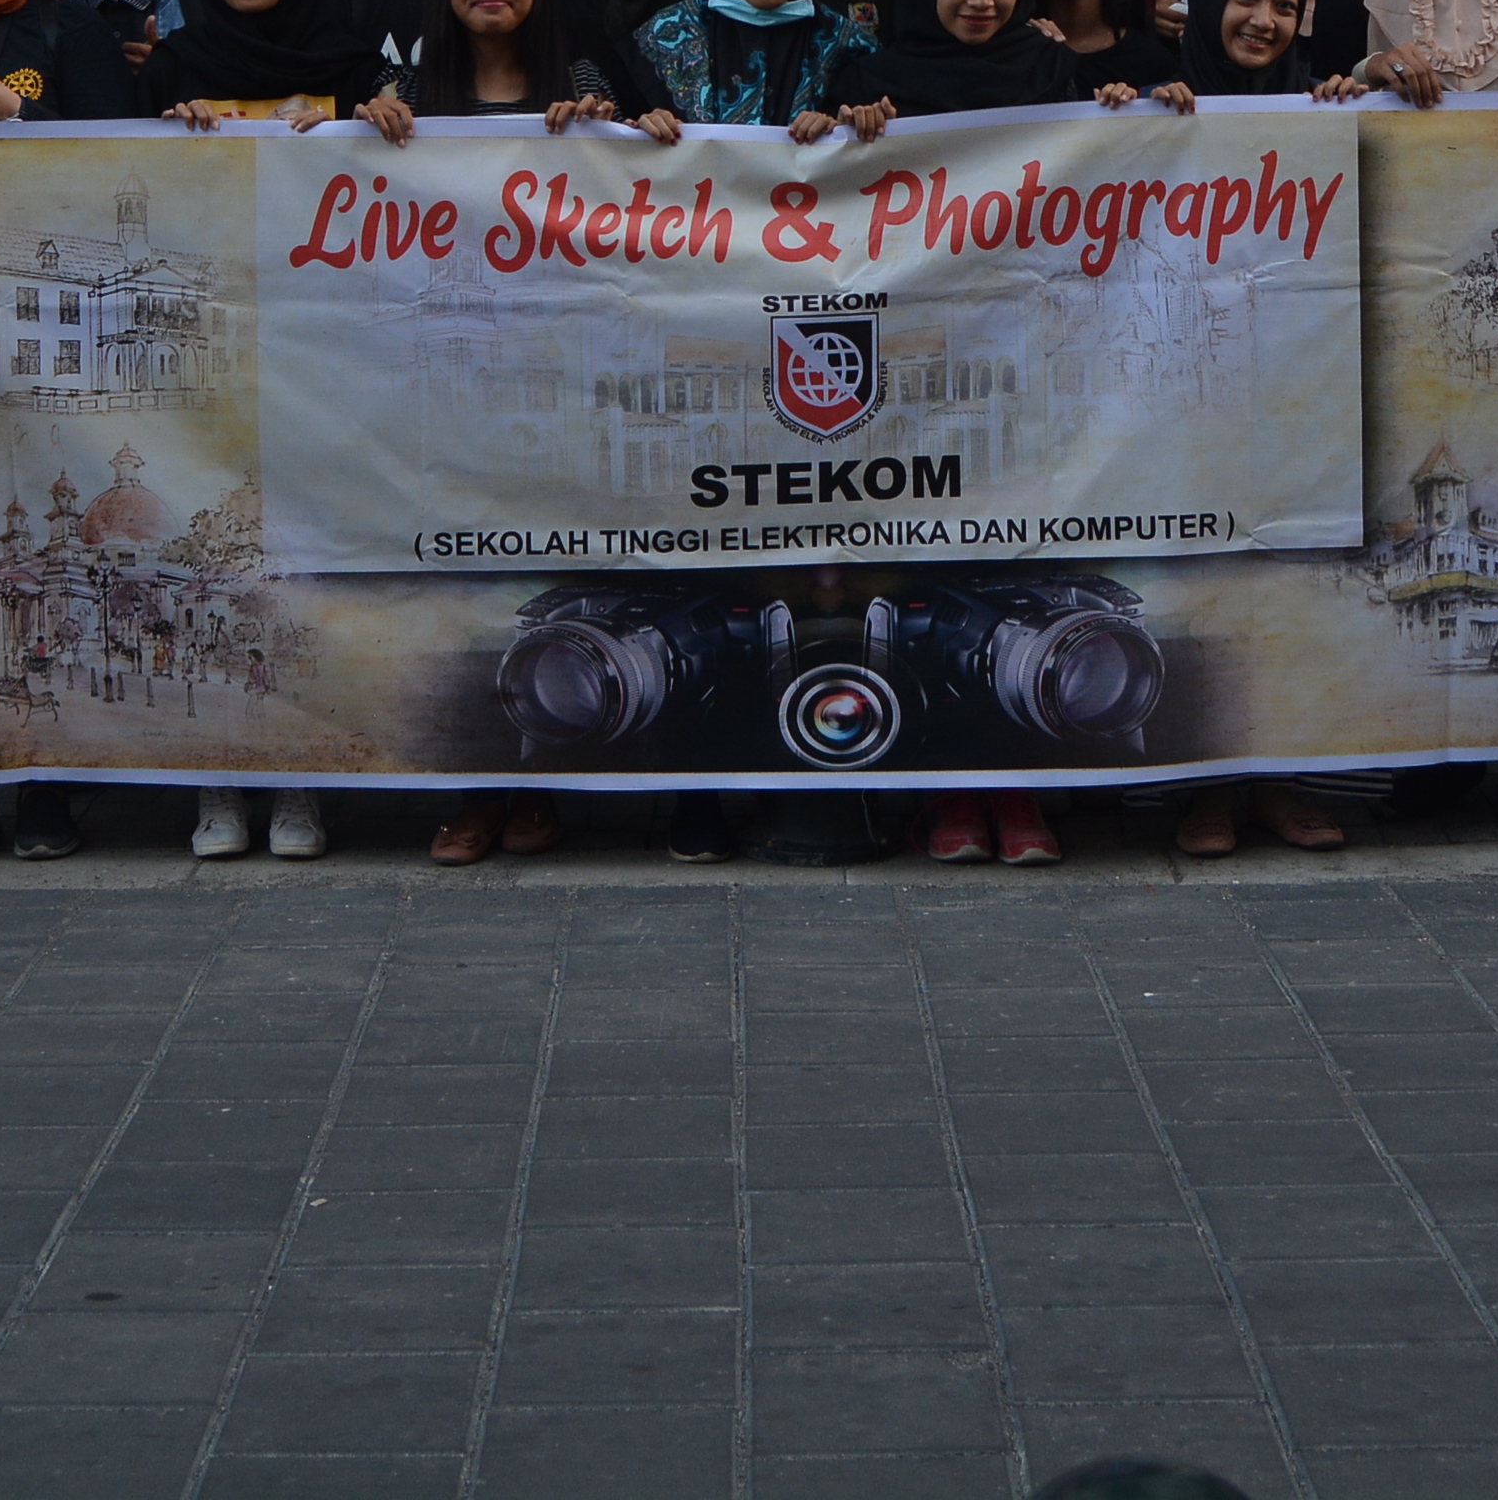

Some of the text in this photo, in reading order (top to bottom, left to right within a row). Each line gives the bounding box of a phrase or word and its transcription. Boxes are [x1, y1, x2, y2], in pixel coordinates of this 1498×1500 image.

[289, 150, 1343, 277] Live Sketch & Photography
[762, 293, 888, 313] STEKOM
[762, 367, 776, 412] SEKOLAH
[772, 410, 801, 435] TINGGI
[867, 411, 876, 421] &
[873, 360, 889, 414] KOMPUTER
[690, 455, 961, 508] STEKOM
[433, 529, 589, 557] SEKOLAH
[599, 527, 709, 555] TINGGI
[720, 520, 951, 551] ELEKTRONIKA
[960, 518, 1027, 544] DAN
[1039, 512, 1218, 542] KOMPUTER
